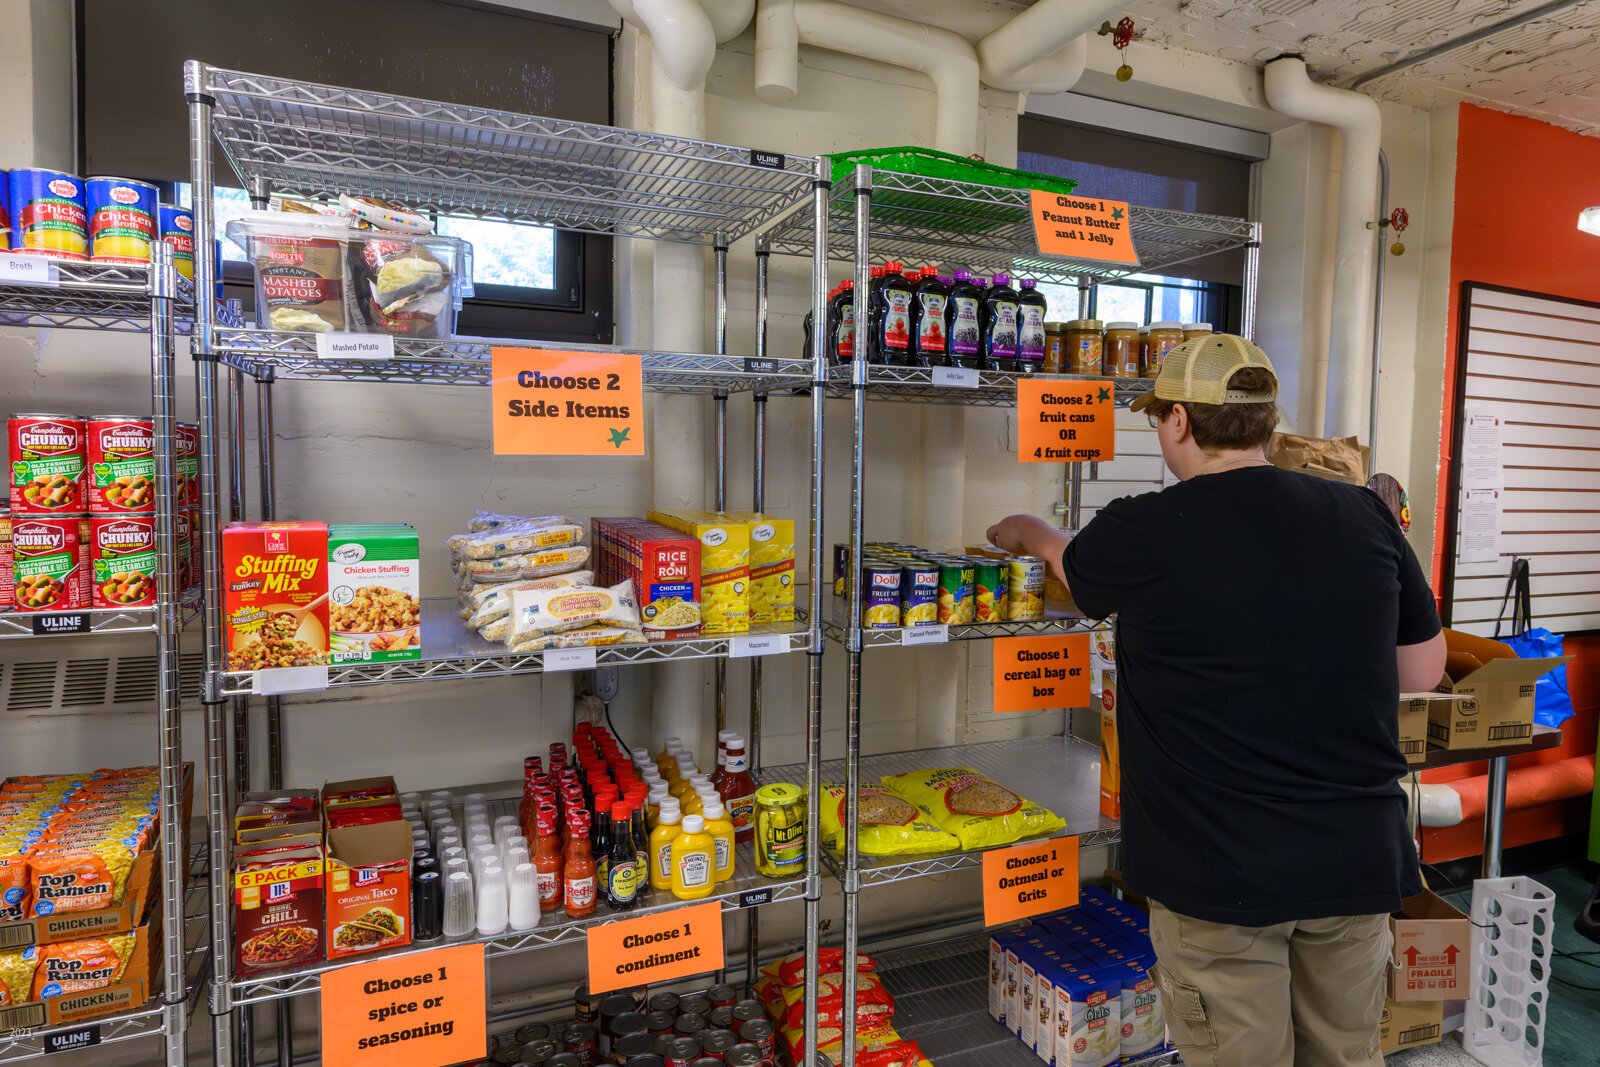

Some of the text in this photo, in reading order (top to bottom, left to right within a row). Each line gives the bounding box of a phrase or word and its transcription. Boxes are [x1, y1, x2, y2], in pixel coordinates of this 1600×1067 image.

[756, 154, 779, 164] ULINE
[1056, 196, 1105, 212] Choose 1
[35, 204, 87, 222] Chicken
[53, 213, 77, 223] Broth
[99, 211, 152, 228] Chicken
[113, 220, 139, 229] Broth
[1042, 210, 1120, 230] Peanut Butter
[1055, 230, 1114, 246] and 1 Jelly
[10, 261, 33, 270] Broth
[269, 267, 308, 277] INSTANT
[263, 276, 317, 288] MASHED
[332, 342, 379, 352] Mashed Potato
[751, 361, 773, 369] ULINE
[517, 370, 621, 391] Choose 2
[1041, 393, 1093, 405] Choose 2
[508, 399, 630, 419] Side Items
[1039, 412, 1095, 423] fruit cans
[21, 433, 75, 447] CHUNKY
[1059, 429, 1077, 440] OR
[103, 435, 152, 448] CHUNKY
[1034, 447, 1100, 461] 4 fruit cups
[46, 459, 81, 467] FASHIONED
[31, 466, 70, 476] VEGETABLE
[113, 466, 149, 477] VEGETABLE
[13, 533, 61, 546] CHUNKY
[100, 532, 150, 545] CHUNKY
[31, 558, 68, 567] FASHIONED
[658, 551, 687, 562] RICE
[20, 566, 54, 576] VEGETABLE
[110, 562, 145, 573] VEGETABLE
[235, 554, 319, 580] Stuffing
[344, 565, 410, 574] Chicken Stuffing
[658, 566, 687, 577] RONI
[261, 573, 302, 594] Mix
[874, 574, 899, 586] Dolly
[41, 616, 82, 627] ULINE
[1017, 648, 1069, 662] Choose 1
[1004, 667, 1082, 681] cereal bag or
[1033, 686, 1055, 697] box
[1461, 701, 1476, 709] Dole
[775, 825, 803, 841] Mt. Olive
[1006, 850, 1057, 870] Choose 1
[38, 874, 77, 888] Top
[240, 867, 298, 886] 6 PACK
[355, 878, 382, 887] McCormick
[999, 867, 1064, 889] Oatmeal or
[38, 883, 108, 899] Ramen
[337, 894, 371, 905] ORIGINAL
[370, 887, 398, 899] Taco
[1018, 889, 1047, 903] Grits
[56, 896, 102, 908] CHICKEN
[266, 893, 295, 904] McCormick
[745, 893, 768, 903] ULINE
[261, 909, 298, 924] CHILI
[49, 916, 103, 932] CHICKEN
[622, 923, 692, 949] Choose 1
[46, 958, 83, 973] Top
[615, 946, 701, 975] condiment
[47, 967, 115, 982] Ramen
[1411, 969, 1452, 978] FRAGILE
[63, 979, 109, 992] CHICKEN
[363, 966, 448, 995] Choose 1
[43, 989, 60, 997] ADDED
[60, 992, 114, 1012] CHICKEN
[1132, 993, 1157, 1009] Grits
[368, 996, 444, 1022] spice or
[1084, 1006, 1111, 1023] Grits
[52, 1031, 91, 1046] ULINE
[358, 1020, 454, 1050] seasoning
